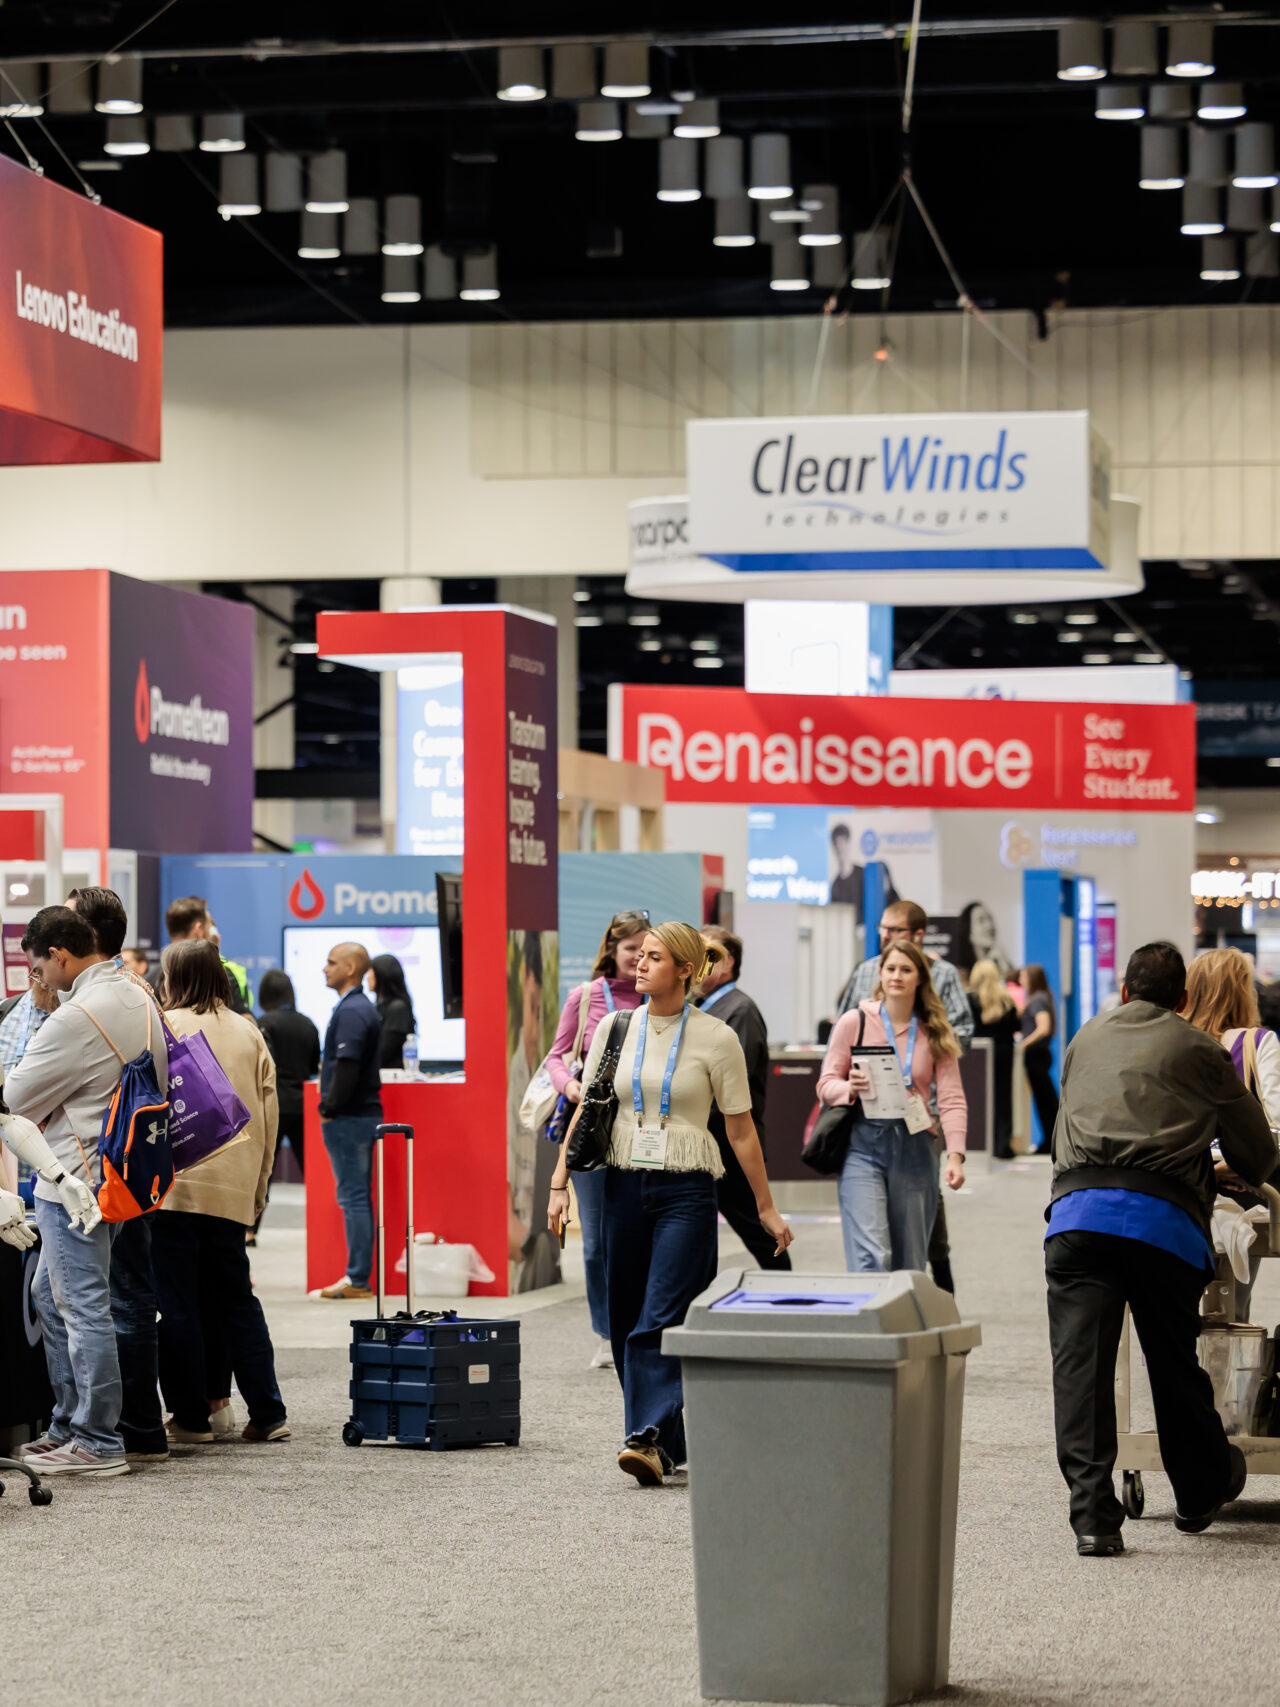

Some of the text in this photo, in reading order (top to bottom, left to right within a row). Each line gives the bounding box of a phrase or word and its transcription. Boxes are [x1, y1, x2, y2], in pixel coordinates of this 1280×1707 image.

[16, 269, 138, 362] Lenovo Education
[752, 429, 1027, 496] ClearWinds
[766, 505, 1010, 528] technologies
[19, 645, 67, 660] seen
[1083, 712, 1125, 740] See
[637, 713, 1033, 789] Renaissance
[1085, 743, 1151, 775] Every
[1083, 772, 1180, 799] Student.
